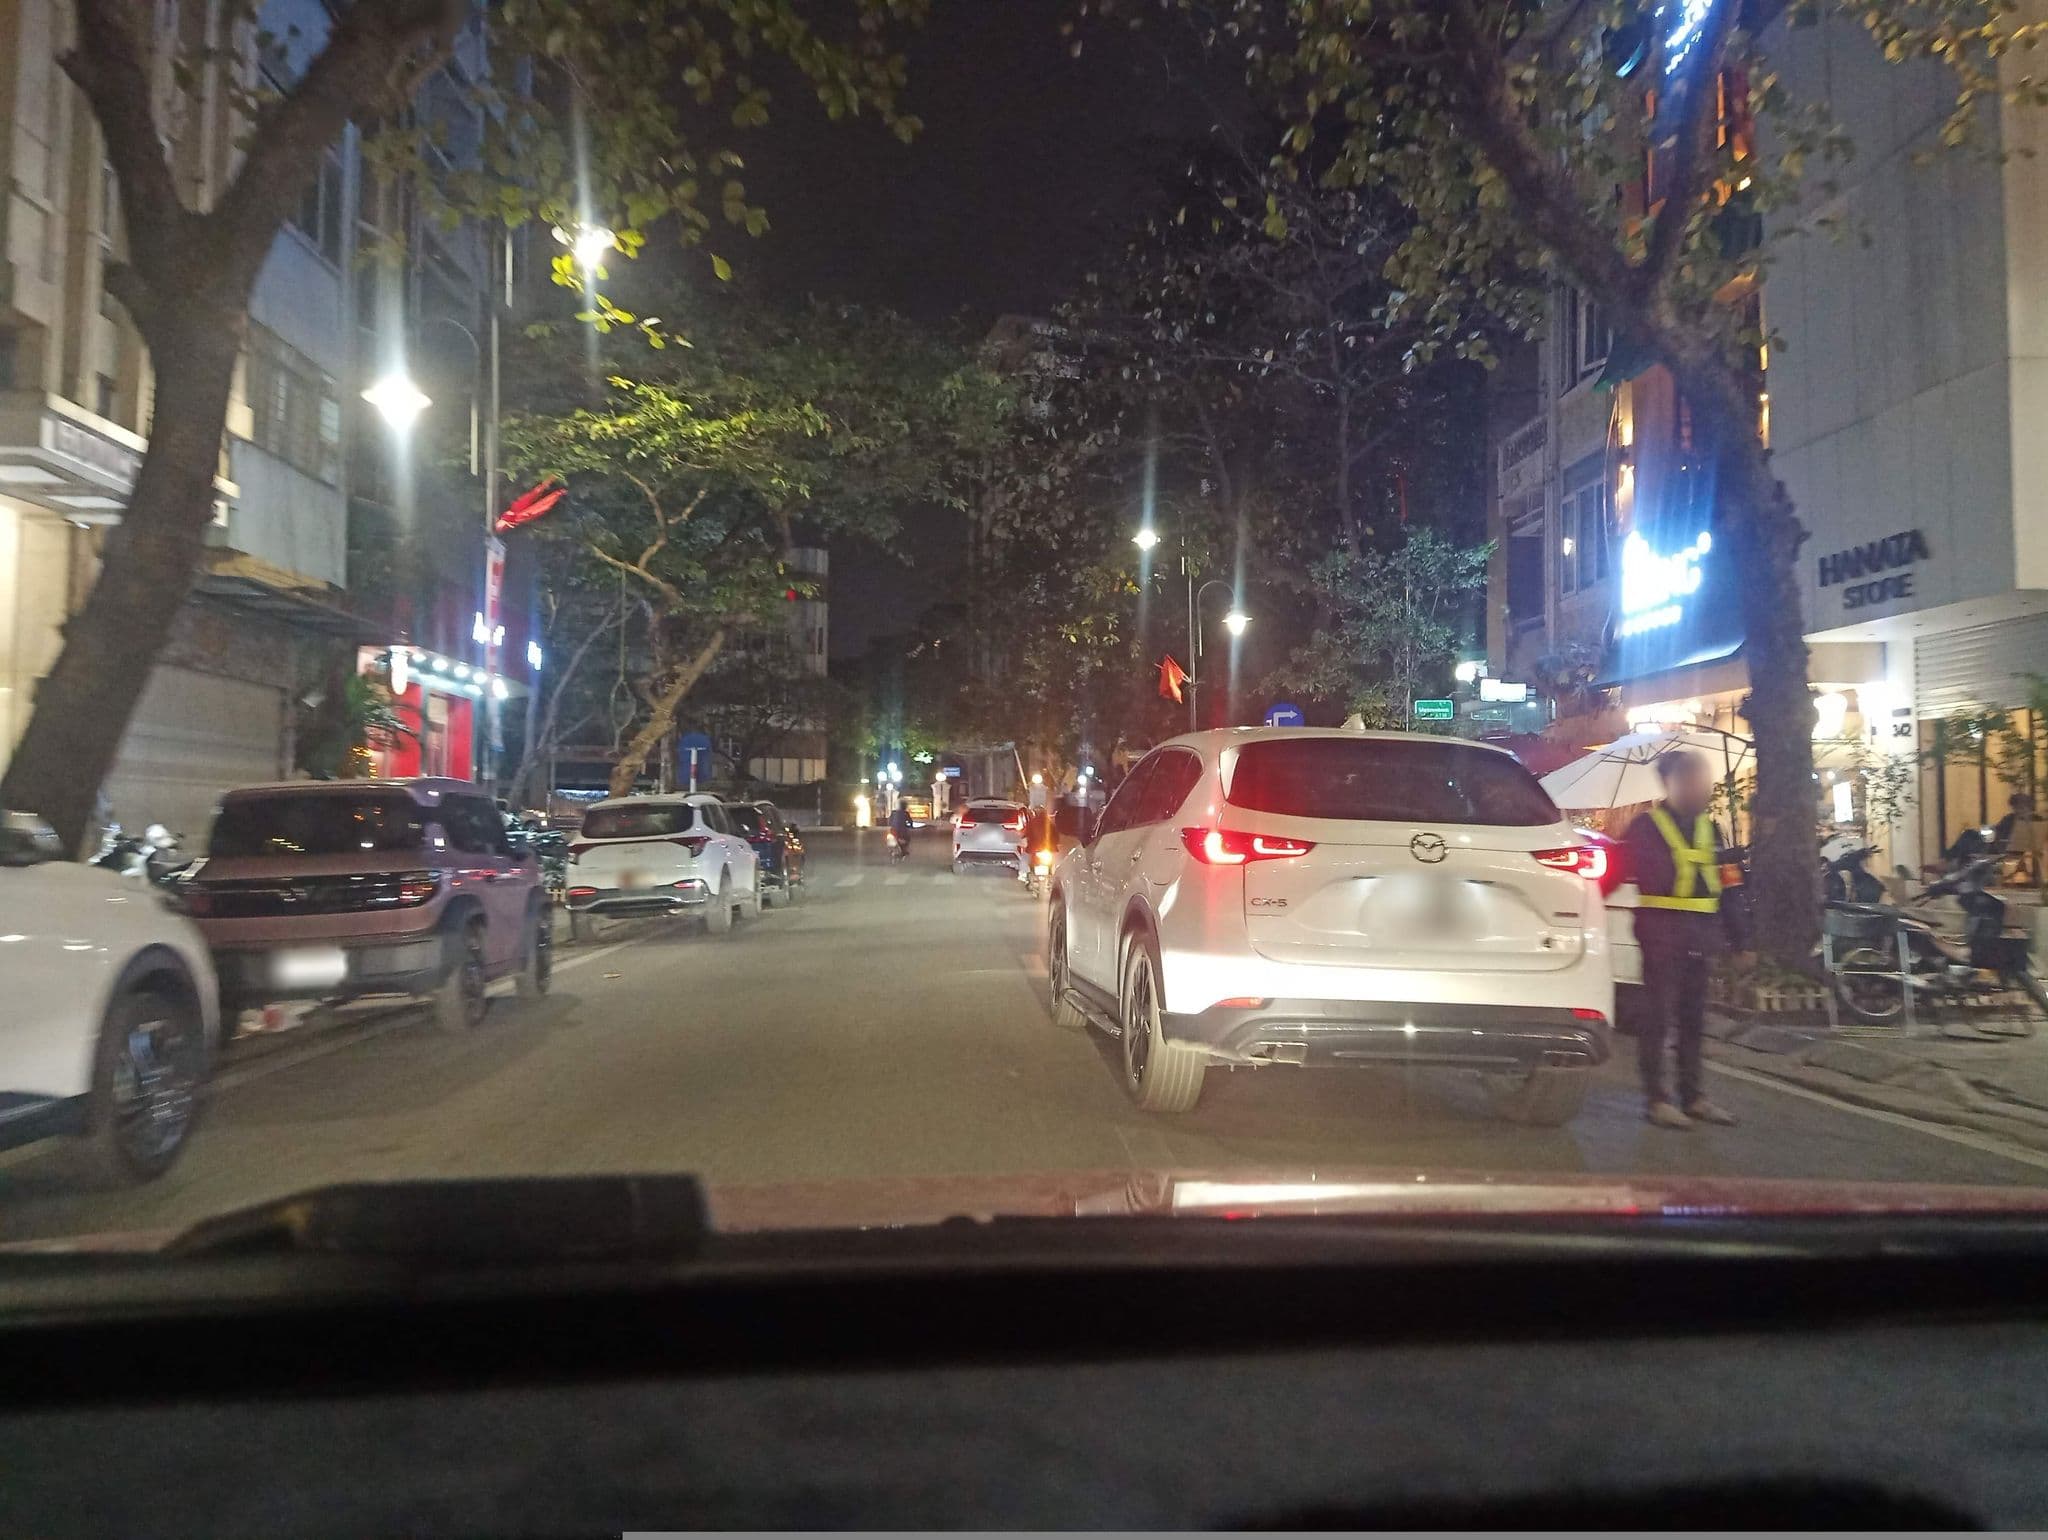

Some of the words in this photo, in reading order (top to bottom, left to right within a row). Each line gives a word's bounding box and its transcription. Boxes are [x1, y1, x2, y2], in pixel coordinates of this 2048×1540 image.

[1818, 528, 1930, 588] HANATA
[1843, 572, 1914, 609] STORE
[1250, 897, 1288, 908] CX-5
